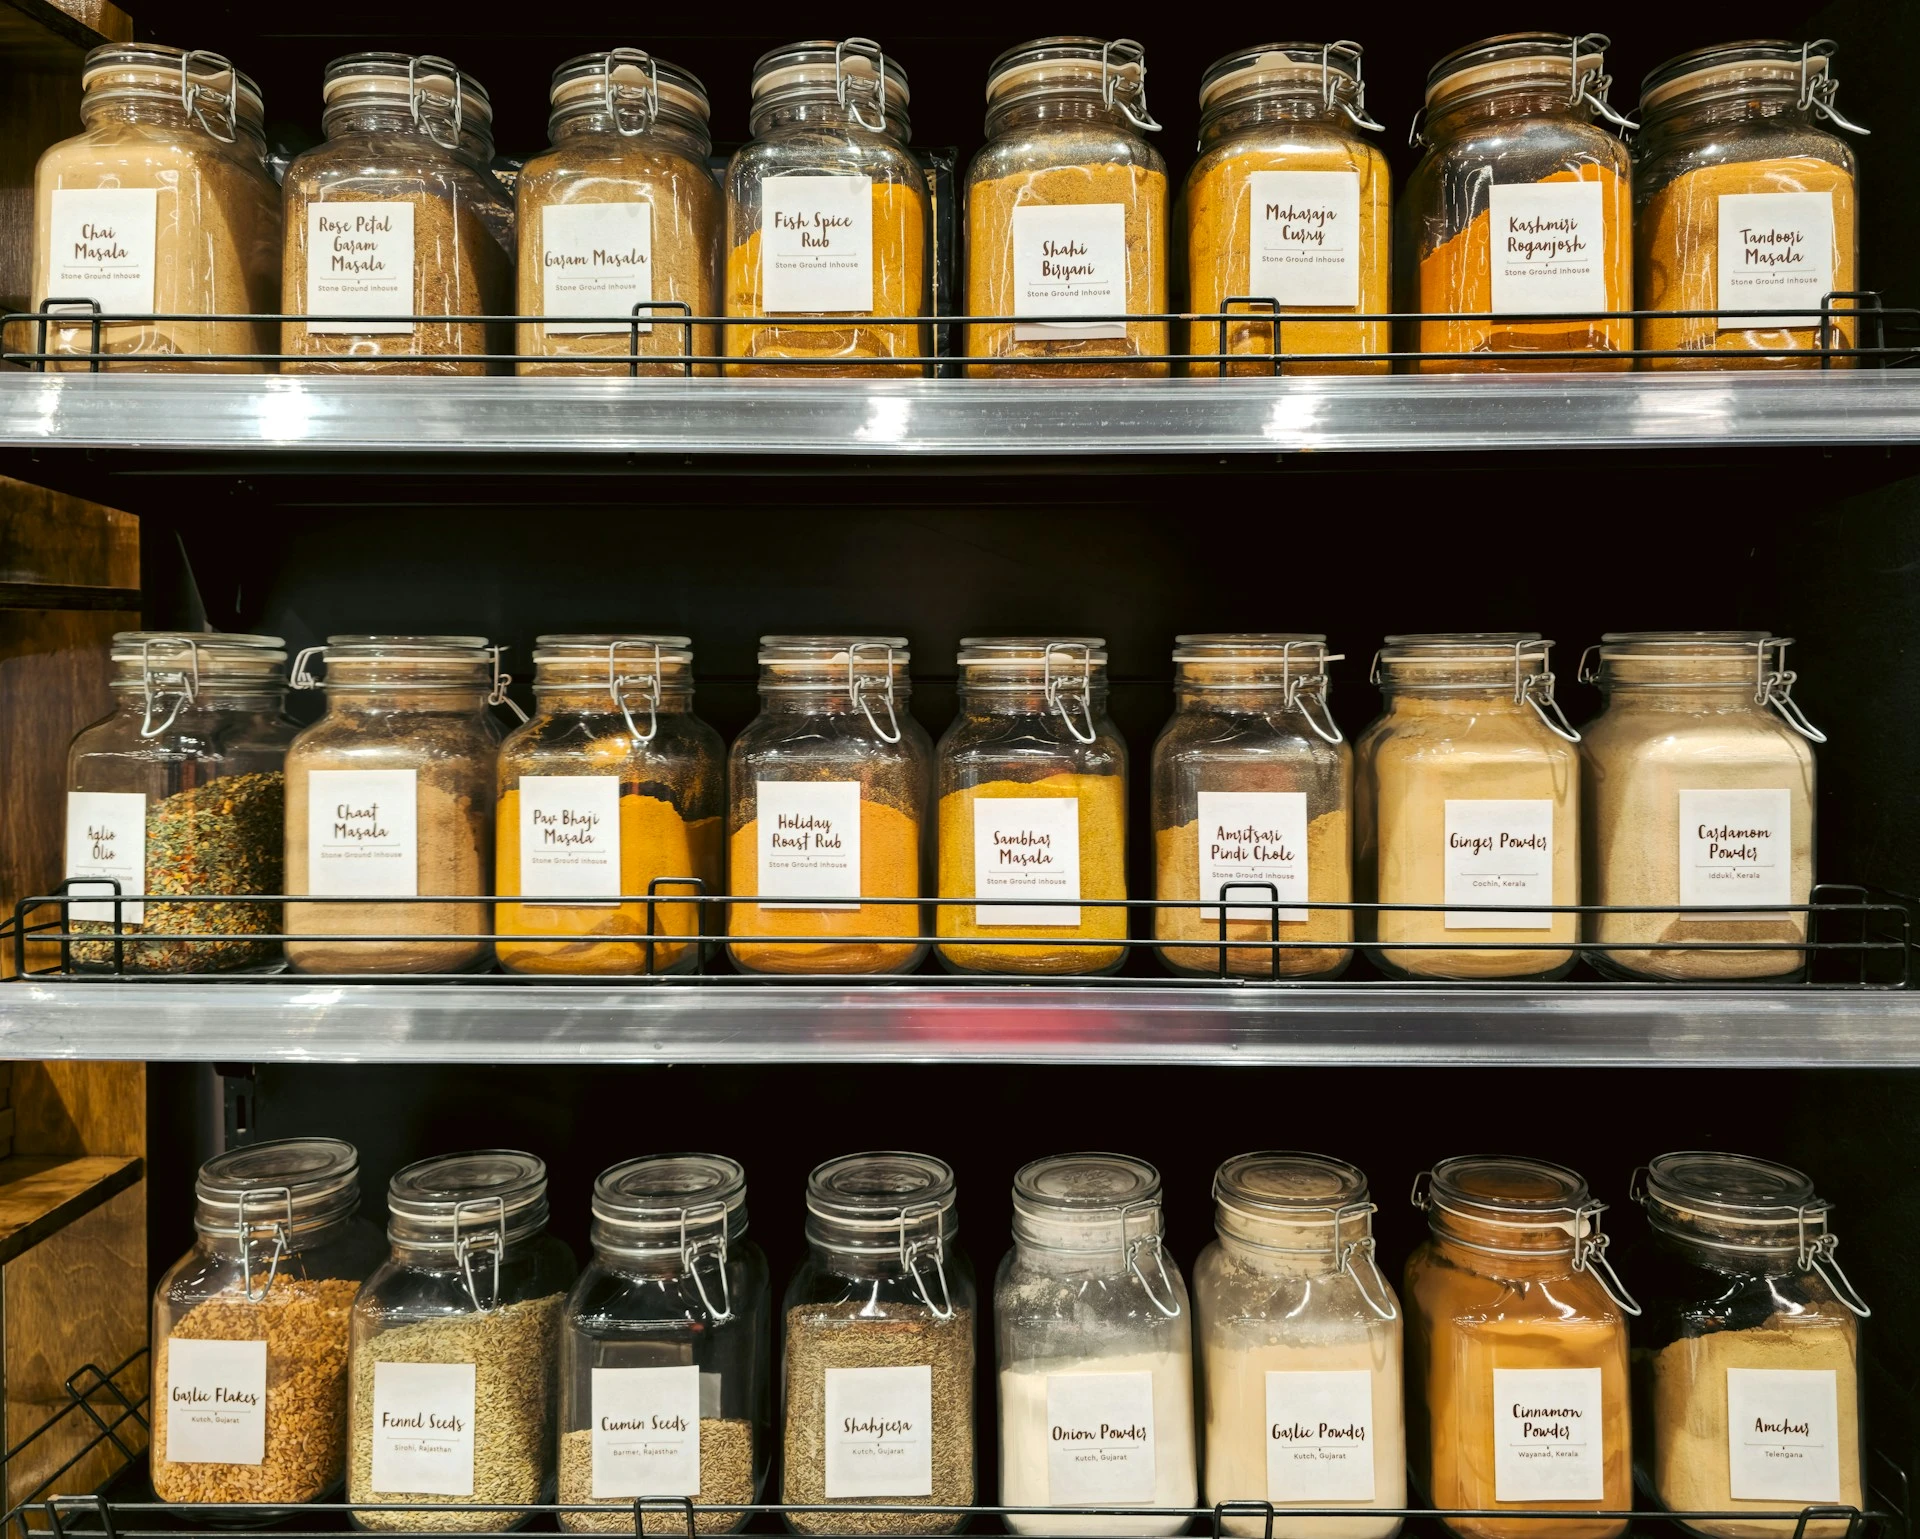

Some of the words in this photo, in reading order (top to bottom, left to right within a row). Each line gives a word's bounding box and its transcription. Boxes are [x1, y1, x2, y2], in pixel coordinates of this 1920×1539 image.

[775, 212, 810, 230] Fish
[814, 212, 853, 235] Spice
[1267, 204, 1337, 227] Maharaja
[82, 224, 116, 240] Chai
[319, 217, 352, 234] Rose
[356, 216, 393, 233] Petal
[1510, 216, 1578, 234] Kashmiri
[802, 231, 830, 247] Rub
[1283, 225, 1326, 245] Curry
[1740, 229, 1804, 246] Tandoori
[75, 243, 128, 261] Masala
[334, 237, 378, 254] Garam
[1043, 240, 1088, 257] Shahi
[1508, 235, 1587, 260] Roganjosh
[332, 255, 385, 273] Masala
[545, 251, 589, 269] Garam
[593, 248, 648, 267] Masala
[1746, 247, 1804, 266] Masala
[1043, 261, 1095, 279] Biryani
[337, 803, 379, 821] Chaat
[534, 810, 558, 825] Pav
[563, 810, 600, 831] Bhaji
[335, 823, 388, 840] Masala
[779, 814, 832, 834] Holiday
[88, 826, 116, 844] Aglio
[545, 829, 595, 846] Masala
[773, 833, 810, 850] Roast
[816, 834, 842, 848] Rub
[994, 831, 1051, 848] Sambhar
[1217, 825, 1282, 844] Amritsari
[1698, 825, 1771, 842] Cardamom
[93, 844, 116, 860] Olio
[1212, 845, 1249, 861] Pindi
[1254, 845, 1295, 861] Chole
[1450, 833, 1493, 855] Ginger
[1500, 833, 1547, 851] Powder
[1710, 844, 1757, 861] Powder
[1000, 849, 1054, 866] Masala
[173, 1387, 211, 1404] Garlic
[216, 1388, 258, 1405] Flakes
[1513, 1404, 1583, 1418] Cinnamon
[383, 1412, 425, 1428] Fennel
[430, 1414, 465, 1432] Seeds
[602, 1417, 645, 1431] Cumin
[652, 1415, 689, 1431] Seeds
[844, 1417, 913, 1438] Shahjeera
[1755, 1418, 1810, 1436] Amchur
[1053, 1426, 1096, 1440] Onion
[1101, 1424, 1147, 1441] Powder
[1272, 1423, 1314, 1441] Garlic
[1319, 1423, 1365, 1440] Powder
[1524, 1423, 1570, 1440] Powder
